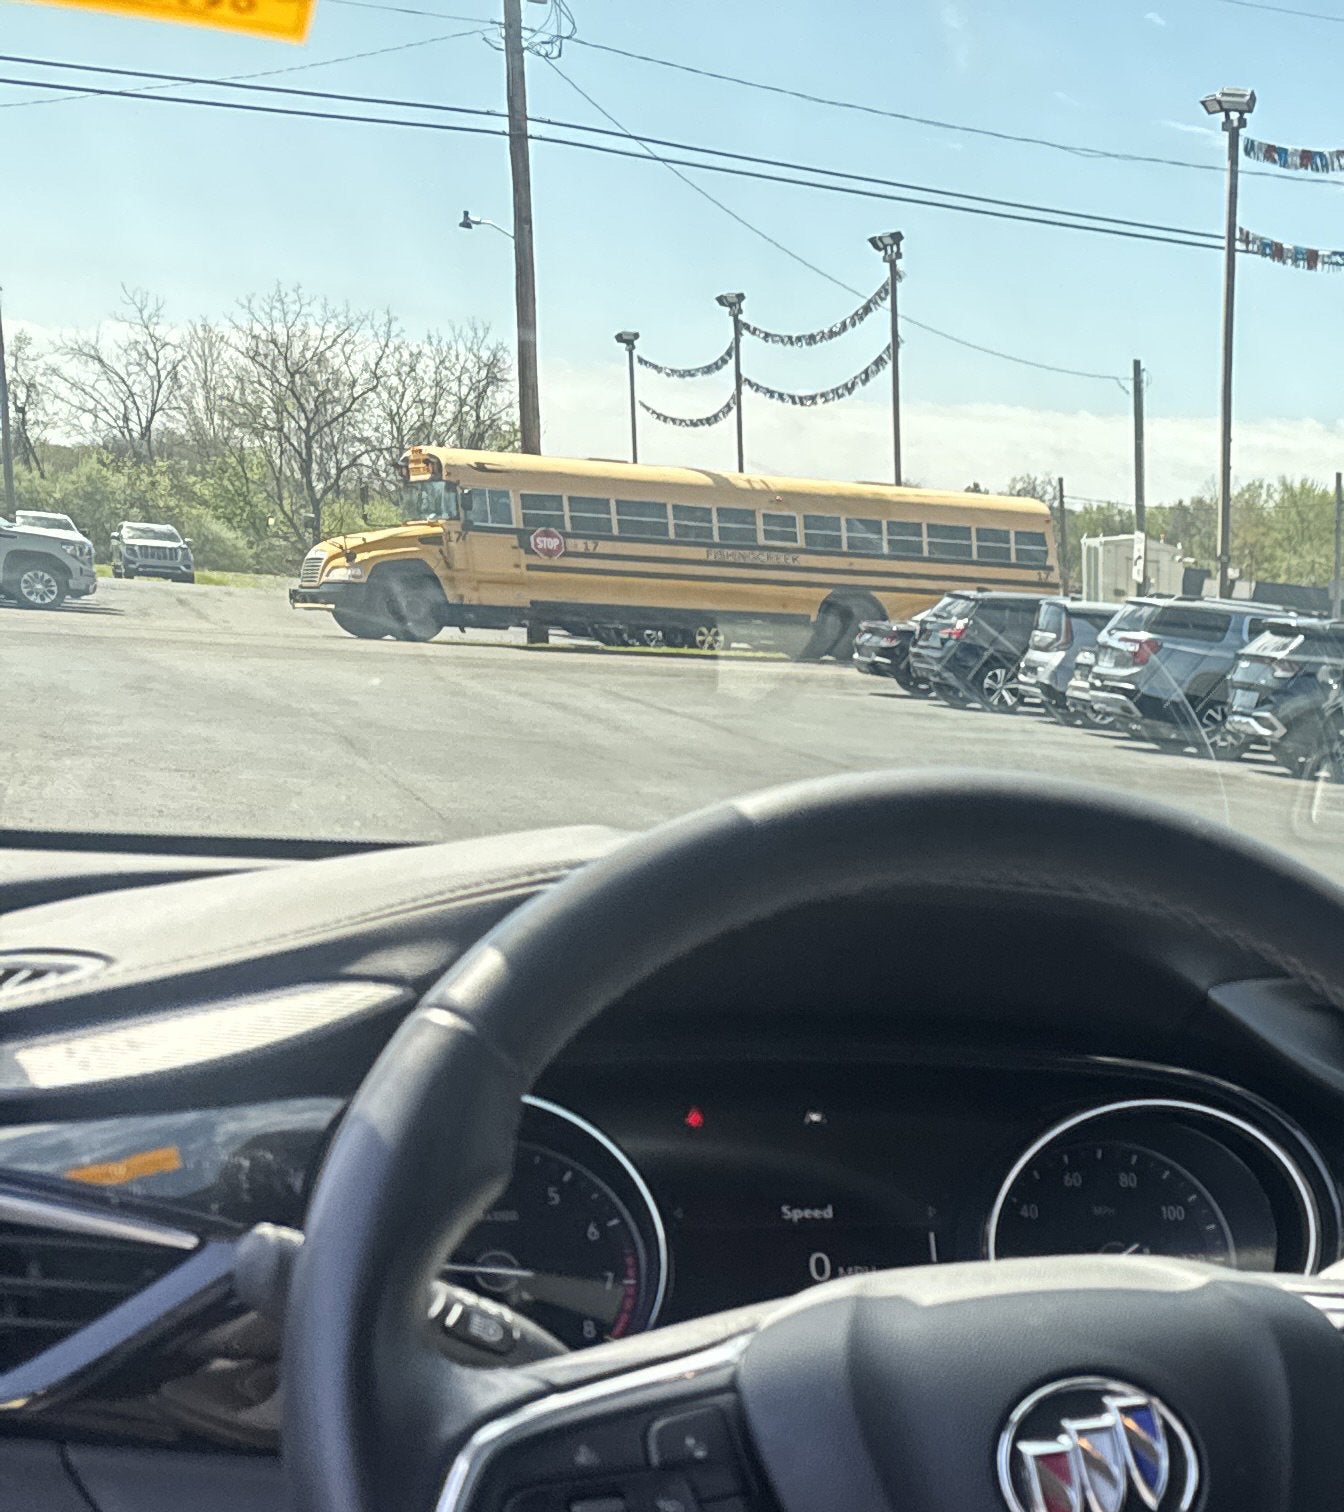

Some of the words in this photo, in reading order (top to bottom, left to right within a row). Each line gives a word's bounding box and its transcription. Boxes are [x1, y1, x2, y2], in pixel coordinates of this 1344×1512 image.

[536, 536, 560, 550] STOP
[584, 541, 600, 553] 17
[1064, 1172, 1083, 1188] 60
[1119, 1172, 1138, 1188] 80
[547, 1187, 561, 1206] 5
[781, 1205, 834, 1221] Speed
[1020, 1204, 1039, 1220] 40
[1161, 1205, 1186, 1222] 100
[586, 1221, 601, 1242] 6
[809, 1252, 832, 1283] 0
[603, 1271, 615, 1291] 7
[582, 1319, 597, 1340] 8
